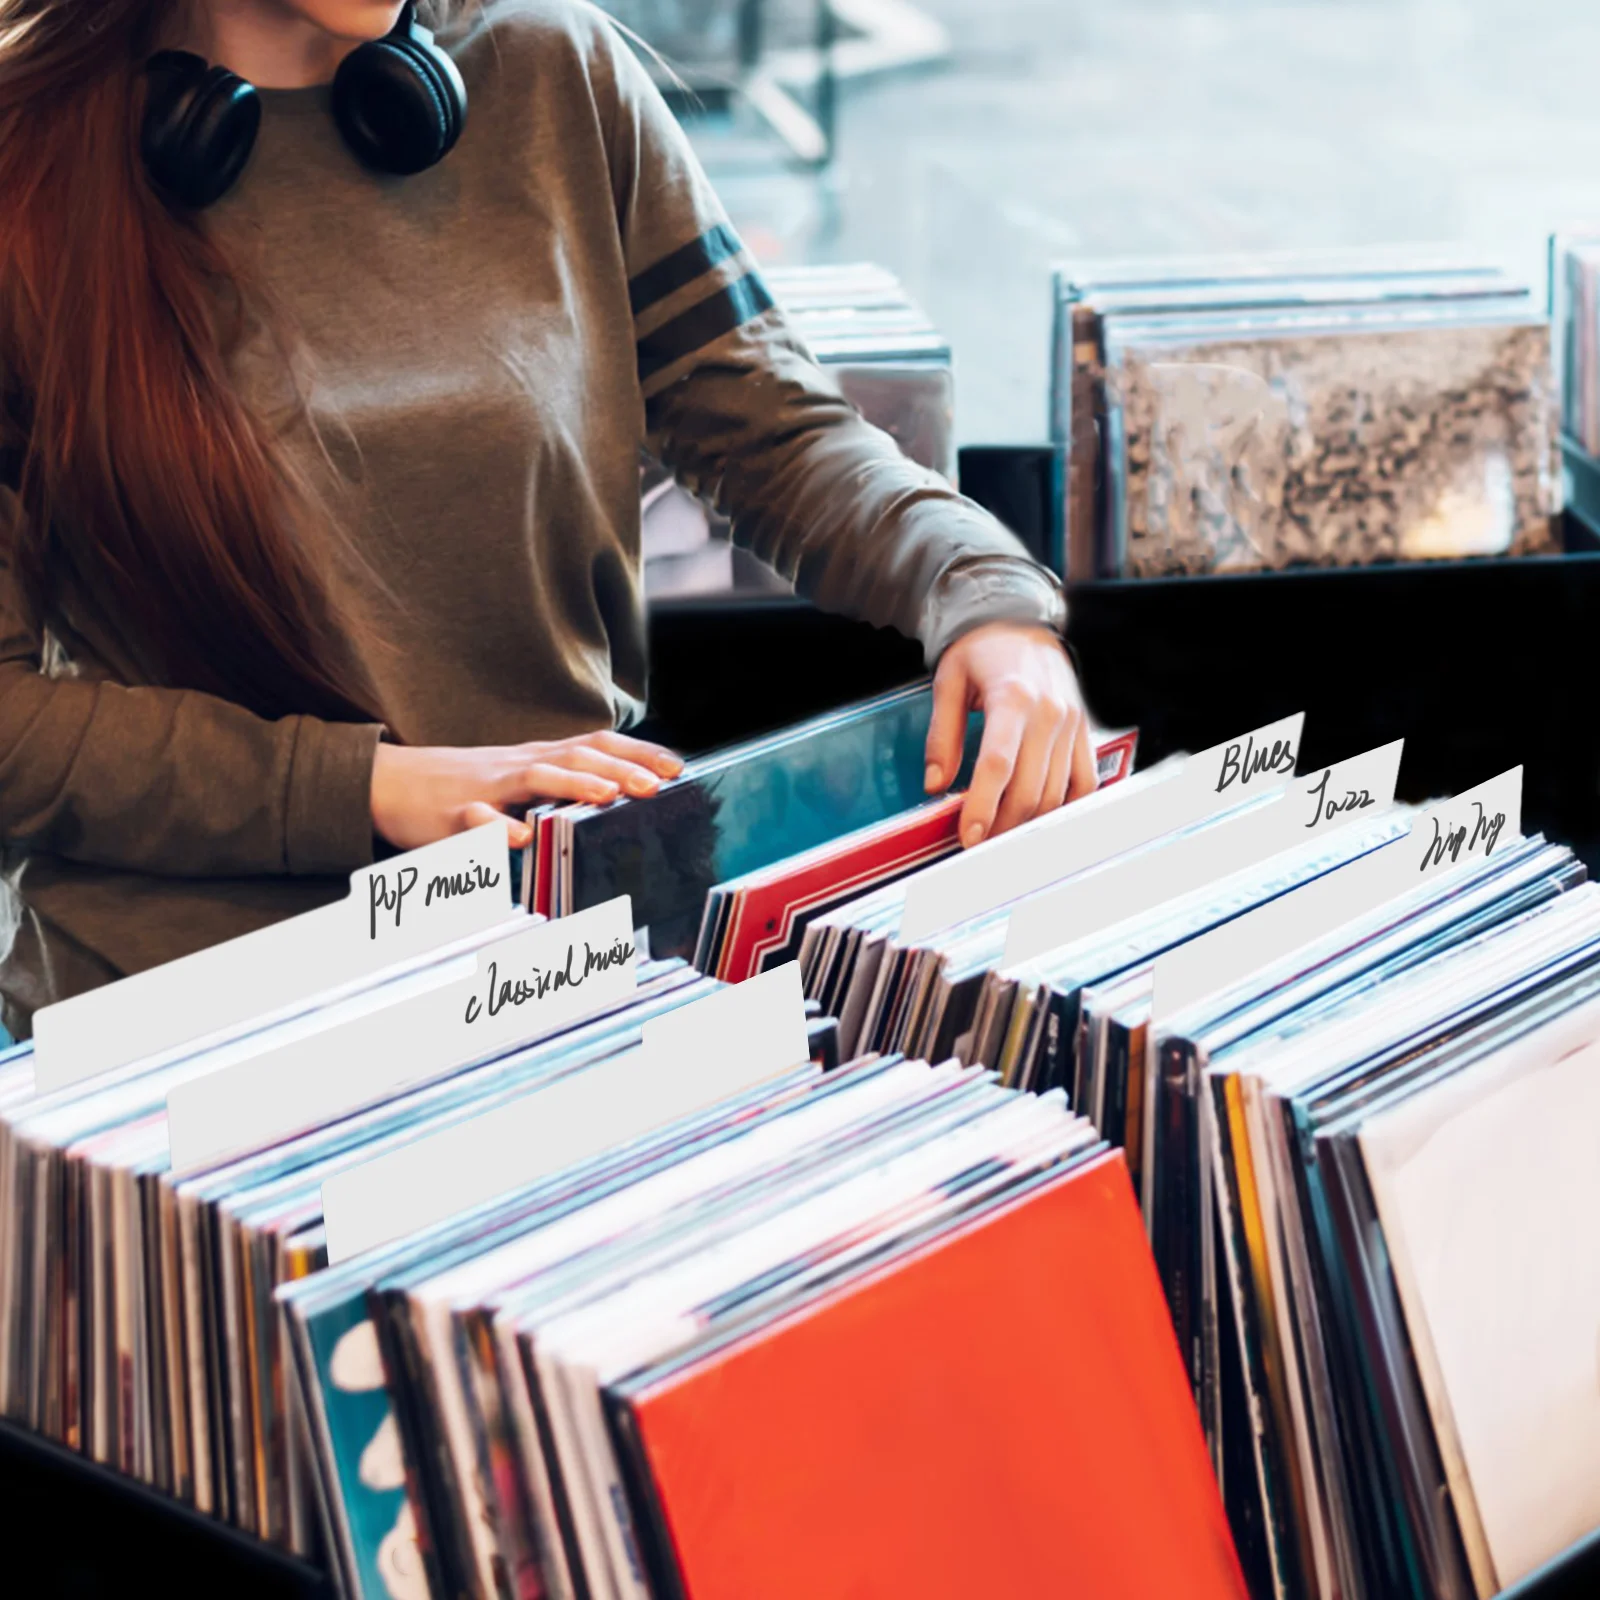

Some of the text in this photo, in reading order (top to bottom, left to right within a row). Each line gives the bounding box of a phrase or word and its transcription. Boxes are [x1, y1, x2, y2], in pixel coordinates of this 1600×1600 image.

[1215, 736, 1296, 792] Blues
[1305, 769, 1376, 828] Jazz
[425, 859, 500, 907] music
